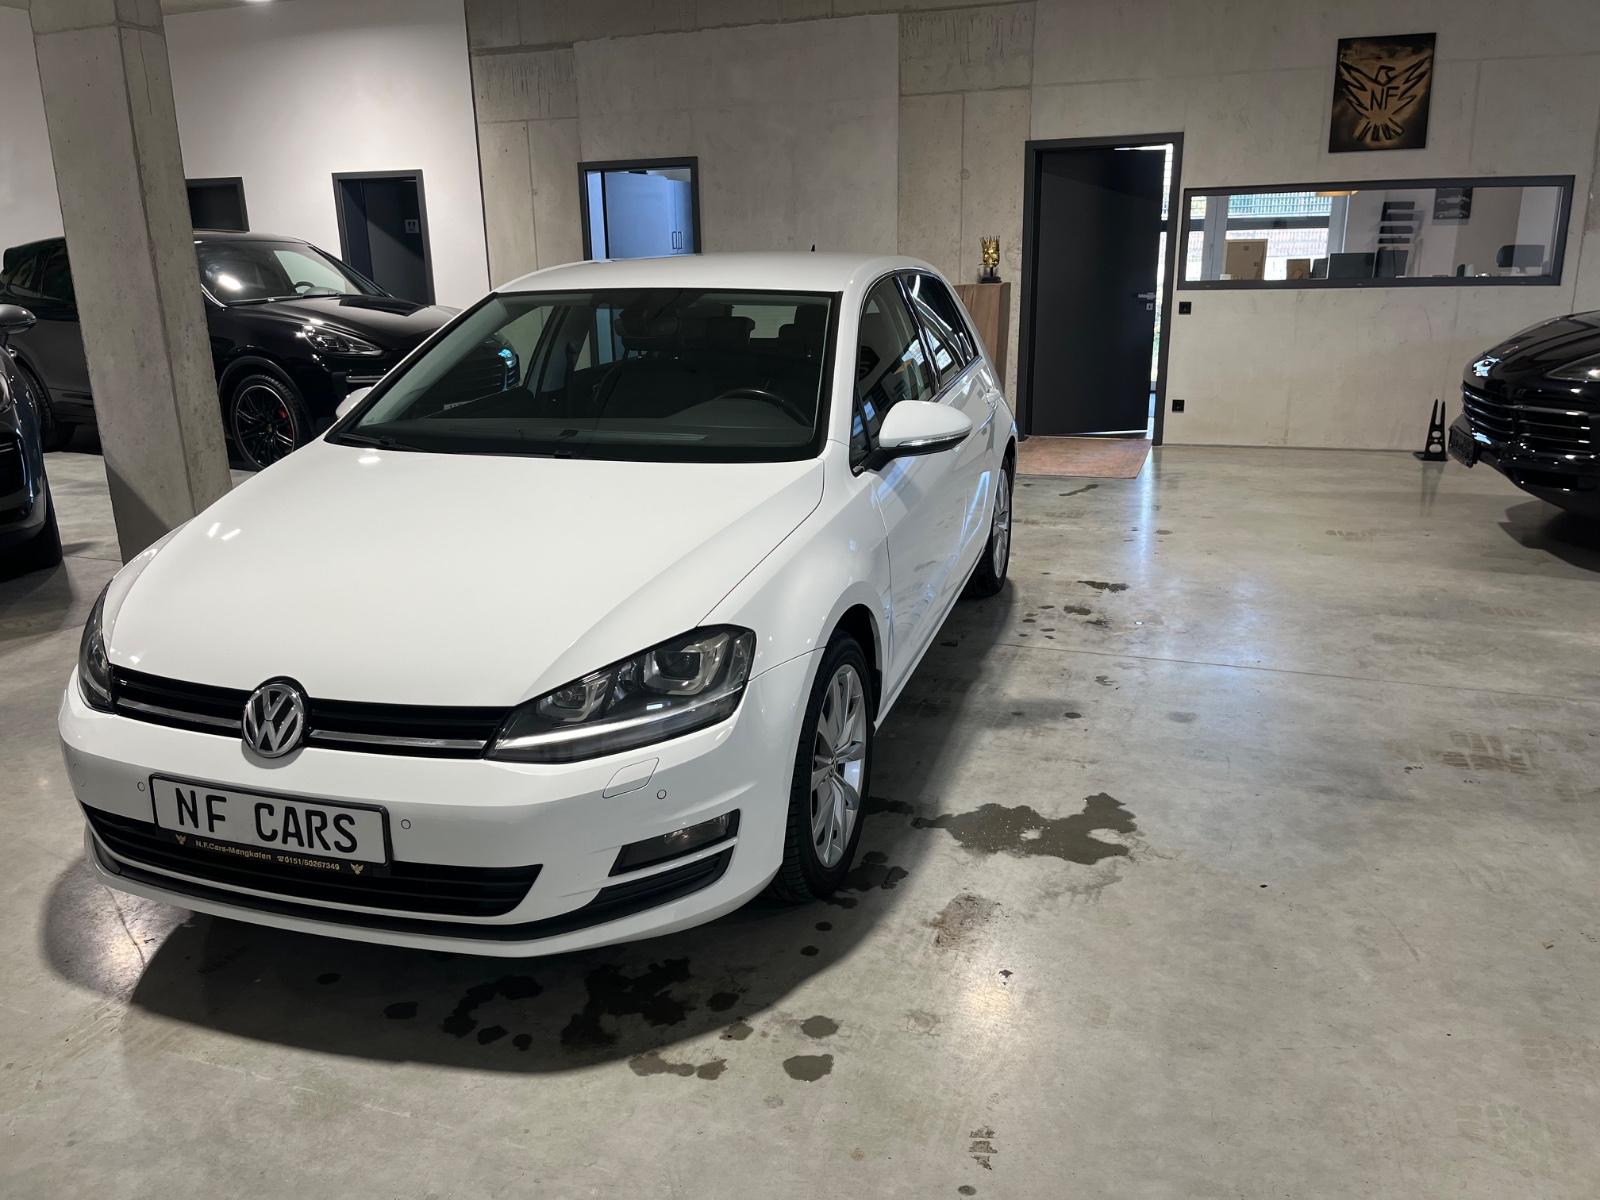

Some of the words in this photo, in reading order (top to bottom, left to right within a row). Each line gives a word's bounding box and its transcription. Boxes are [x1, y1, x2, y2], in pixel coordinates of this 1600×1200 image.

[1370, 86, 1400, 111] NF
[244, 684, 303, 757] VW
[175, 787, 227, 833] NF
[254, 802, 358, 853] CARS
